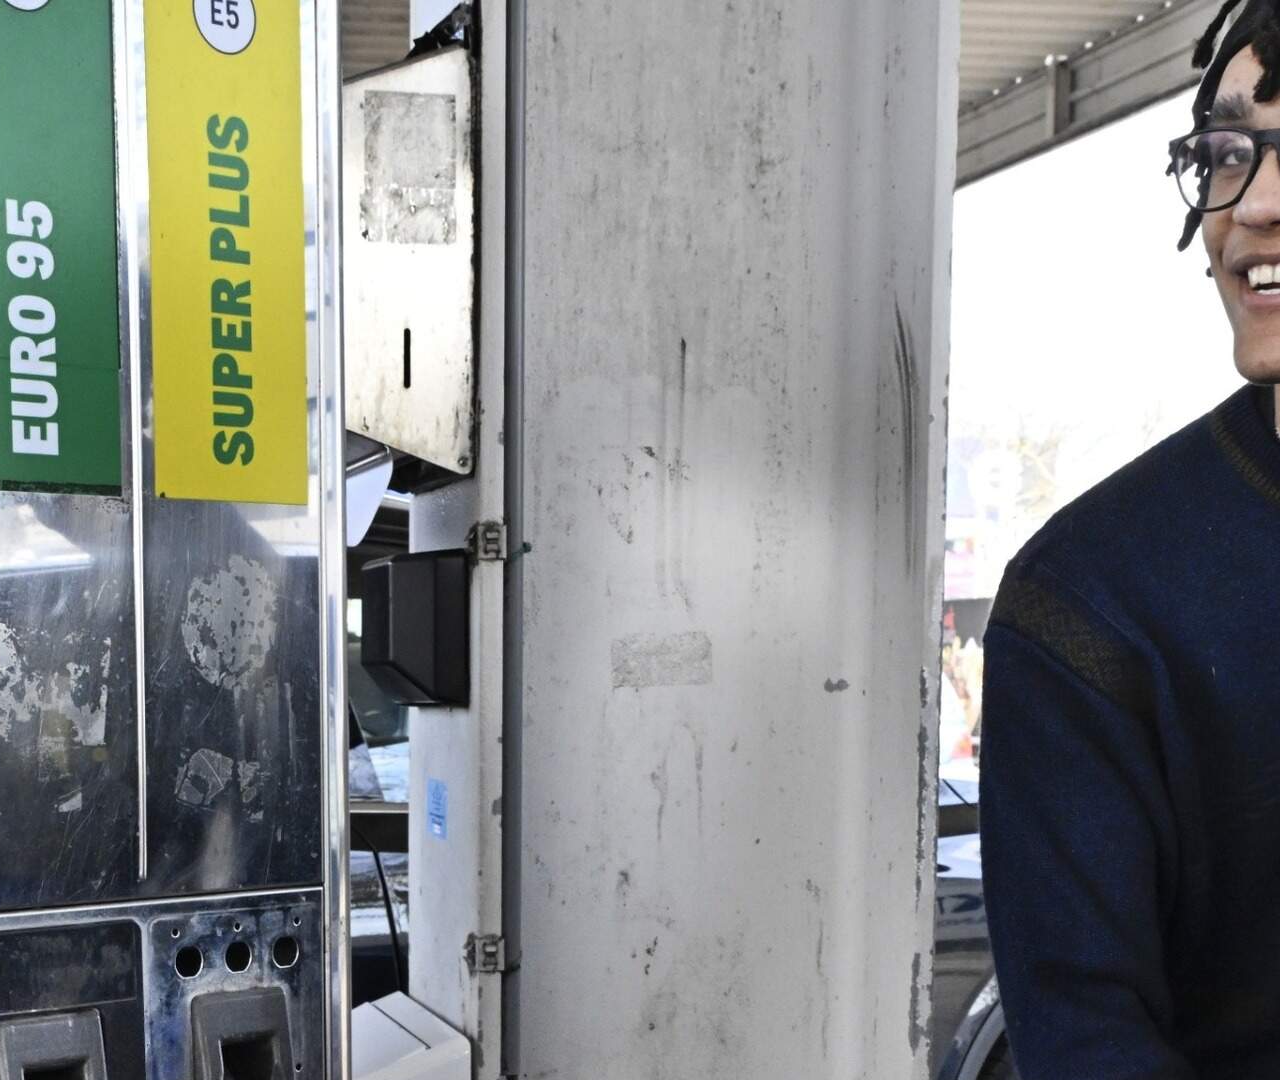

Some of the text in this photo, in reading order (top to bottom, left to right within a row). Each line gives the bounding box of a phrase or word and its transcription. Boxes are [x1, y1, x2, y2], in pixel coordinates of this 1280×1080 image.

[210, 0, 240, 29] E5
[5, 198, 59, 456] EURO 95
[207, 114, 254, 466] SUPER PLUS
